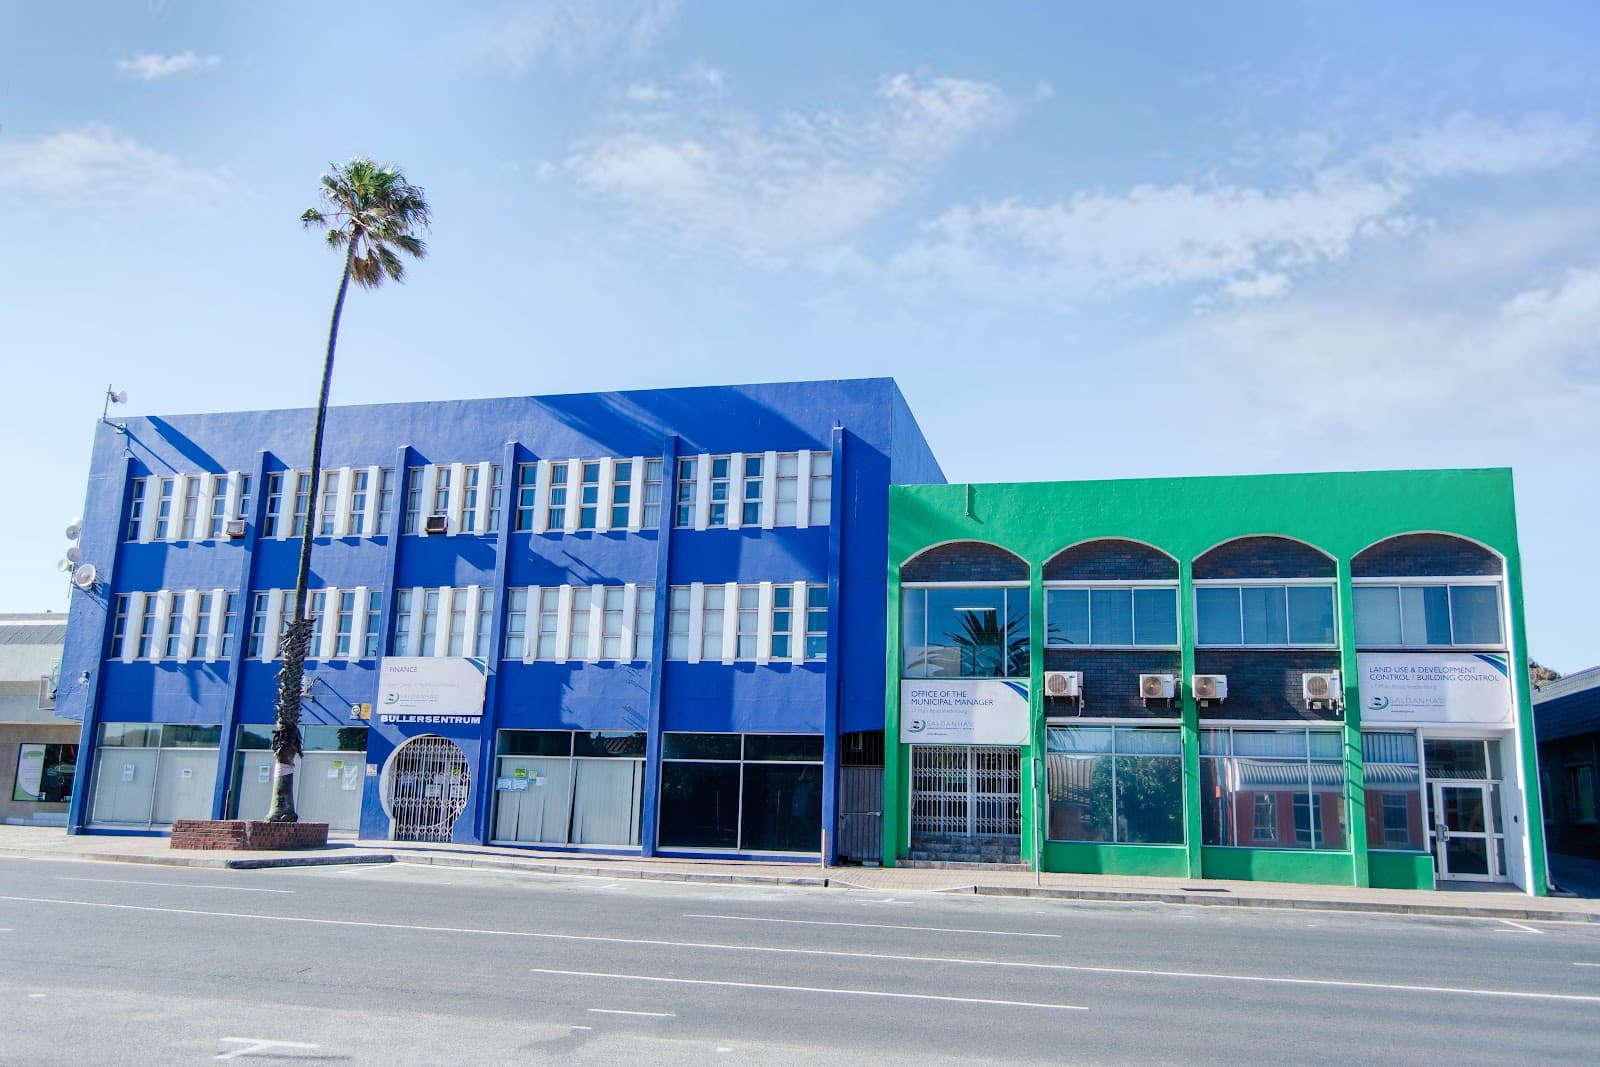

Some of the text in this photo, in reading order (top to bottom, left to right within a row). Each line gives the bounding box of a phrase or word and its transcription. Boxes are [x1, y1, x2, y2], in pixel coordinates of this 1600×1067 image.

[1369, 666, 1476, 675] LAND USE & DEVELOPMENT
[1369, 674, 1410, 682] CONTROL
[1417, 674, 1456, 682] BUILDING
[1458, 674, 1500, 683] CONTROL
[911, 690, 967, 698] OFFICE OF THE
[911, 698, 994, 706] MUNICIPAL MANAGER
[380, 714, 481, 725] BULLERSENTRUM
